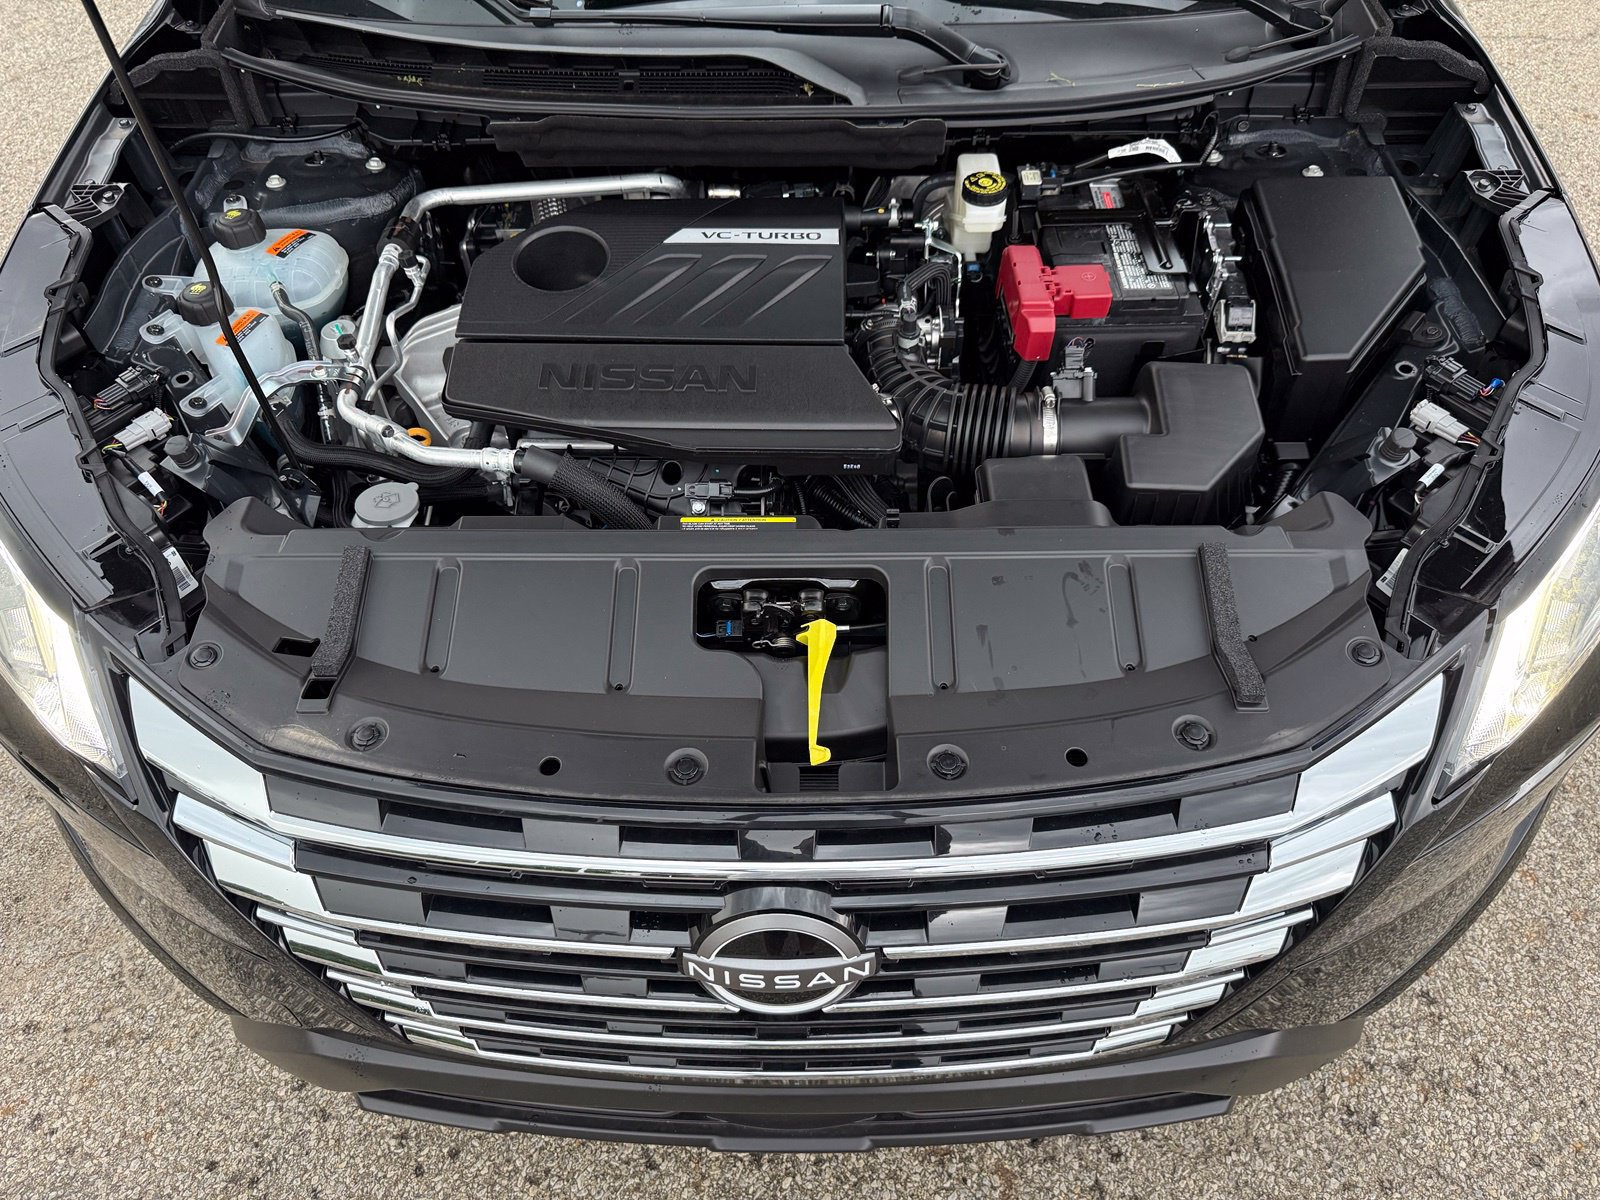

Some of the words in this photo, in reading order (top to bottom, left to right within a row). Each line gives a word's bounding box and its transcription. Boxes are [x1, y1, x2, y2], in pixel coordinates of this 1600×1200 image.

[701, 231, 822, 241] VC-TURBO
[537, 362, 758, 393] NISSAN
[687, 960, 871, 990] NISSAN
